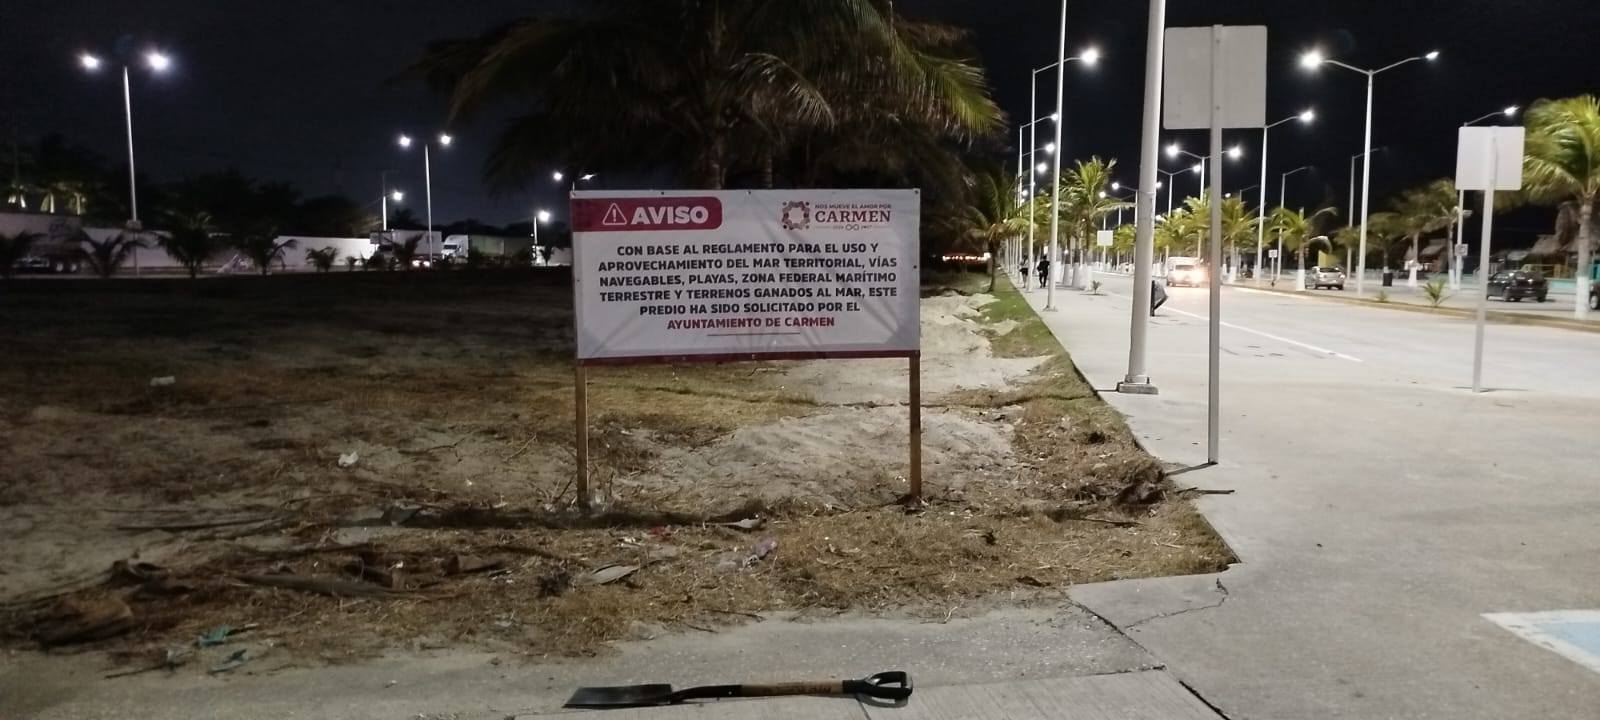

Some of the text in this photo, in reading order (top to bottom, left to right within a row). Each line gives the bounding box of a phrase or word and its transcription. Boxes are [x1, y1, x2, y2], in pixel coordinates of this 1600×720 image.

[631, 206, 709, 225] AVISO
[815, 210, 891, 222] CARMEN
[617, 243, 878, 256] CON BASE AL REGLAMENTO PARA EL USO Y
[598, 256, 897, 272] APROVECHAMIENTO DEL MAR TERRITORIAL, VÍAS
[600, 271, 896, 286] NAVEGABLES, PLAYAS, ZONA FEDERAL MARÍTIMO
[600, 288, 897, 302] TERRESTRE Y TERRENOS GANADOS AL MAR, ESTE
[640, 302, 860, 315] PREDIO HA SIDO SOLICITADO POR EL
[667, 317, 834, 330] AYUNTAMIENTO DE CARMEN
